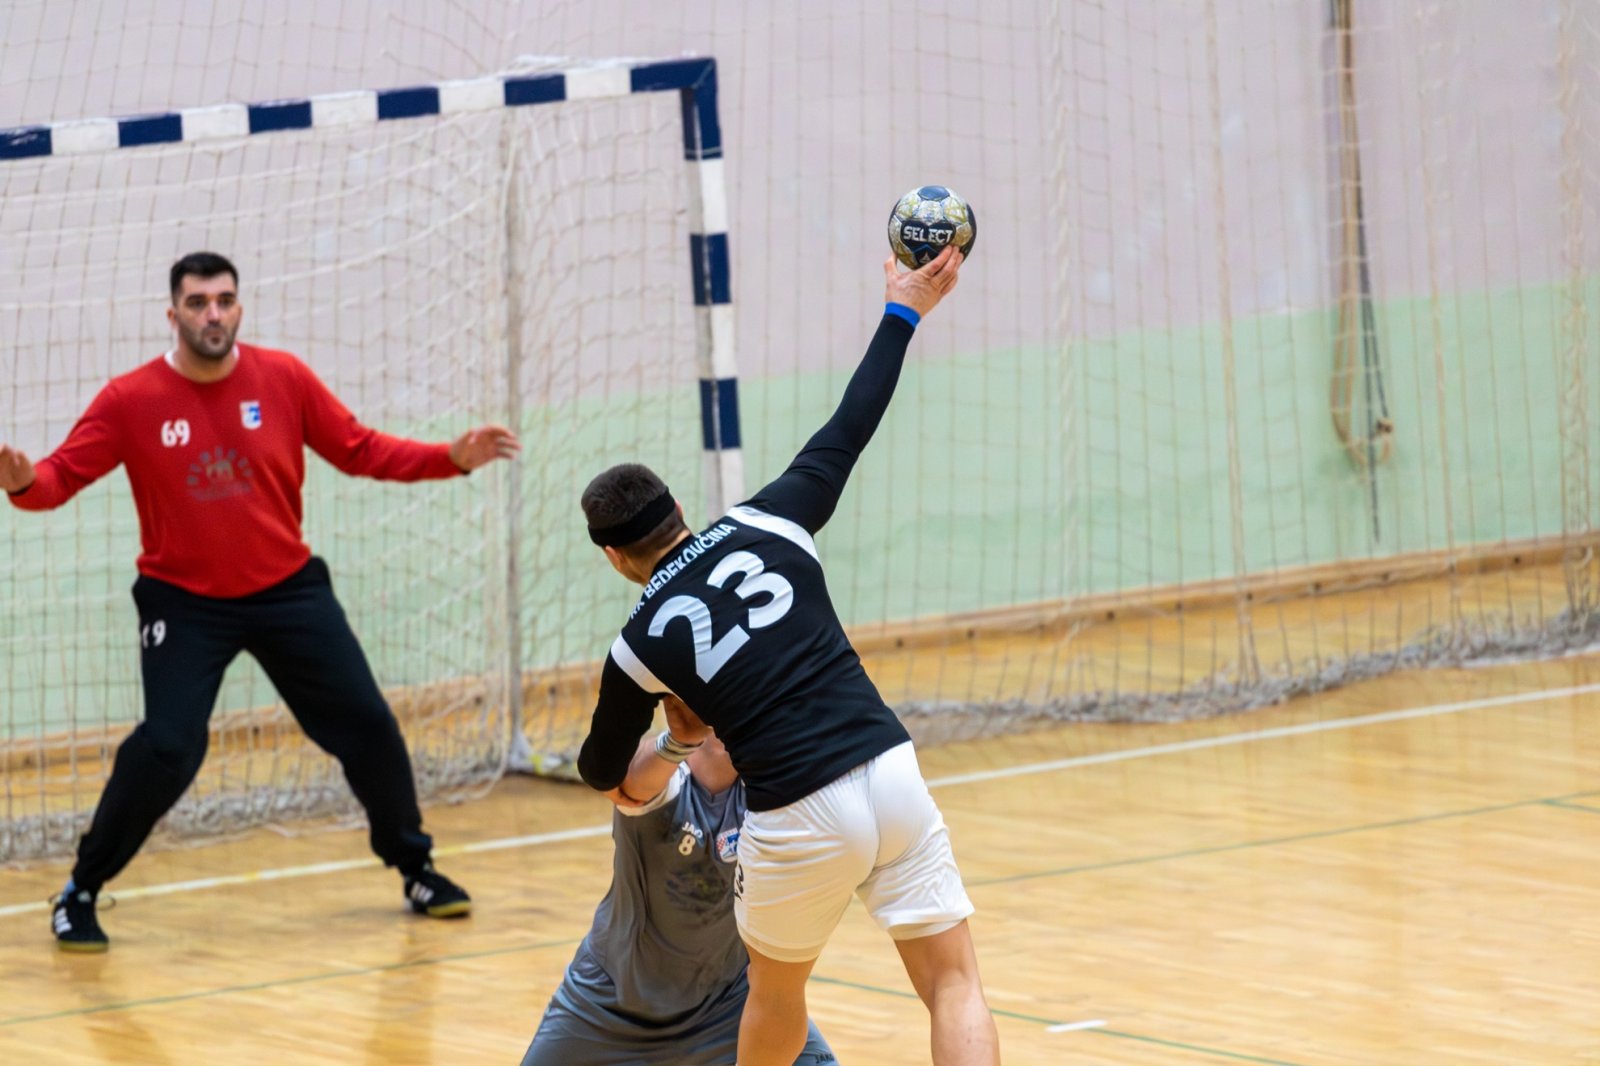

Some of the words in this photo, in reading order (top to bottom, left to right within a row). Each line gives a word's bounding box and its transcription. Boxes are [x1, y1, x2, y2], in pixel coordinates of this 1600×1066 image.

[903, 225, 953, 244] SELECT
[161, 418, 190, 447] 69
[644, 523, 737, 599] BEDEKOVČINA
[648, 550, 794, 684] 23
[678, 834, 696, 855] 8
